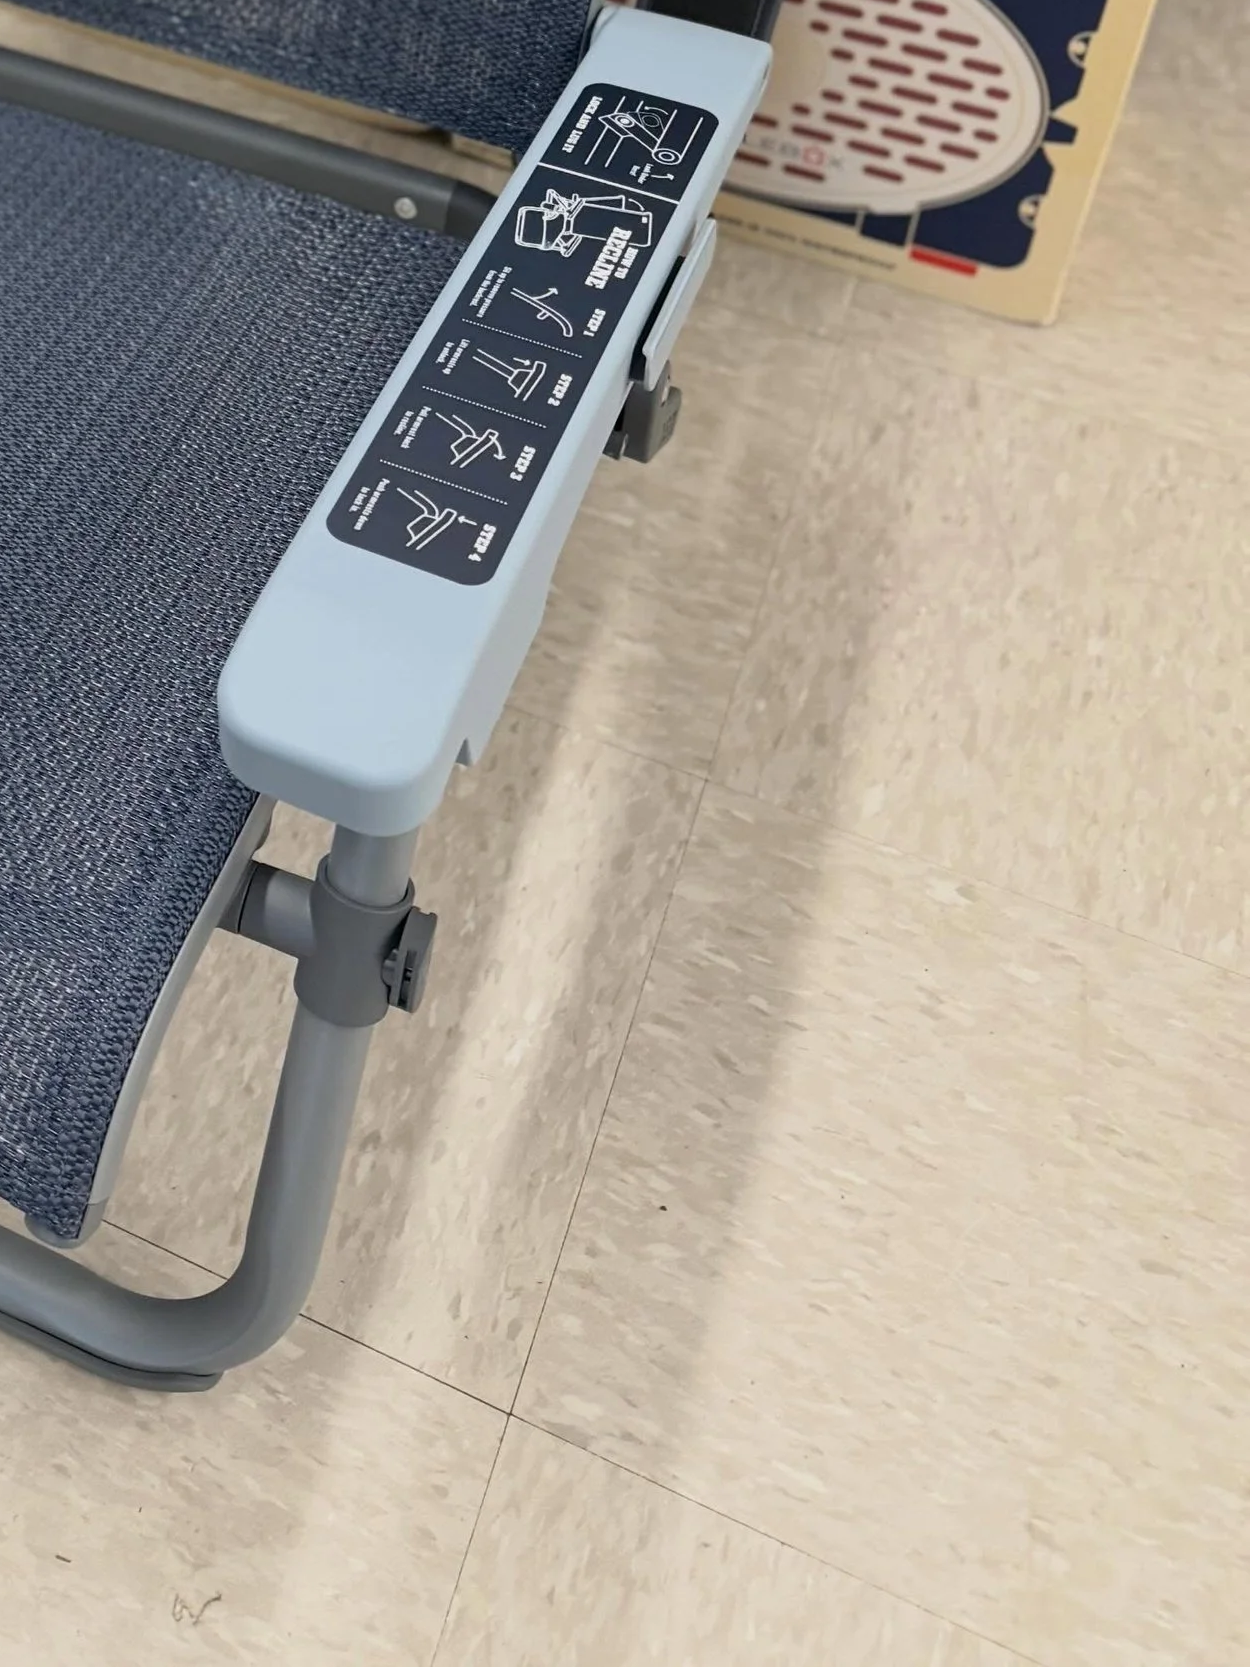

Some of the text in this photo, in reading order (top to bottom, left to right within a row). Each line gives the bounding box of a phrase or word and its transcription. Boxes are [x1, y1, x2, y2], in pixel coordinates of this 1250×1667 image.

[576, 113, 591, 129] AND
[585, 96, 602, 114] LOCK
[562, 143, 574, 153] IT
[585, 227, 632, 289] RECLINE
[614, 247, 638, 279] HOW TO
[587, 309, 606, 332] STEP
[548, 374, 572, 406] STEP 2
[510, 445, 536, 481] STEP 3
[468, 524, 496, 561] STEP 4
